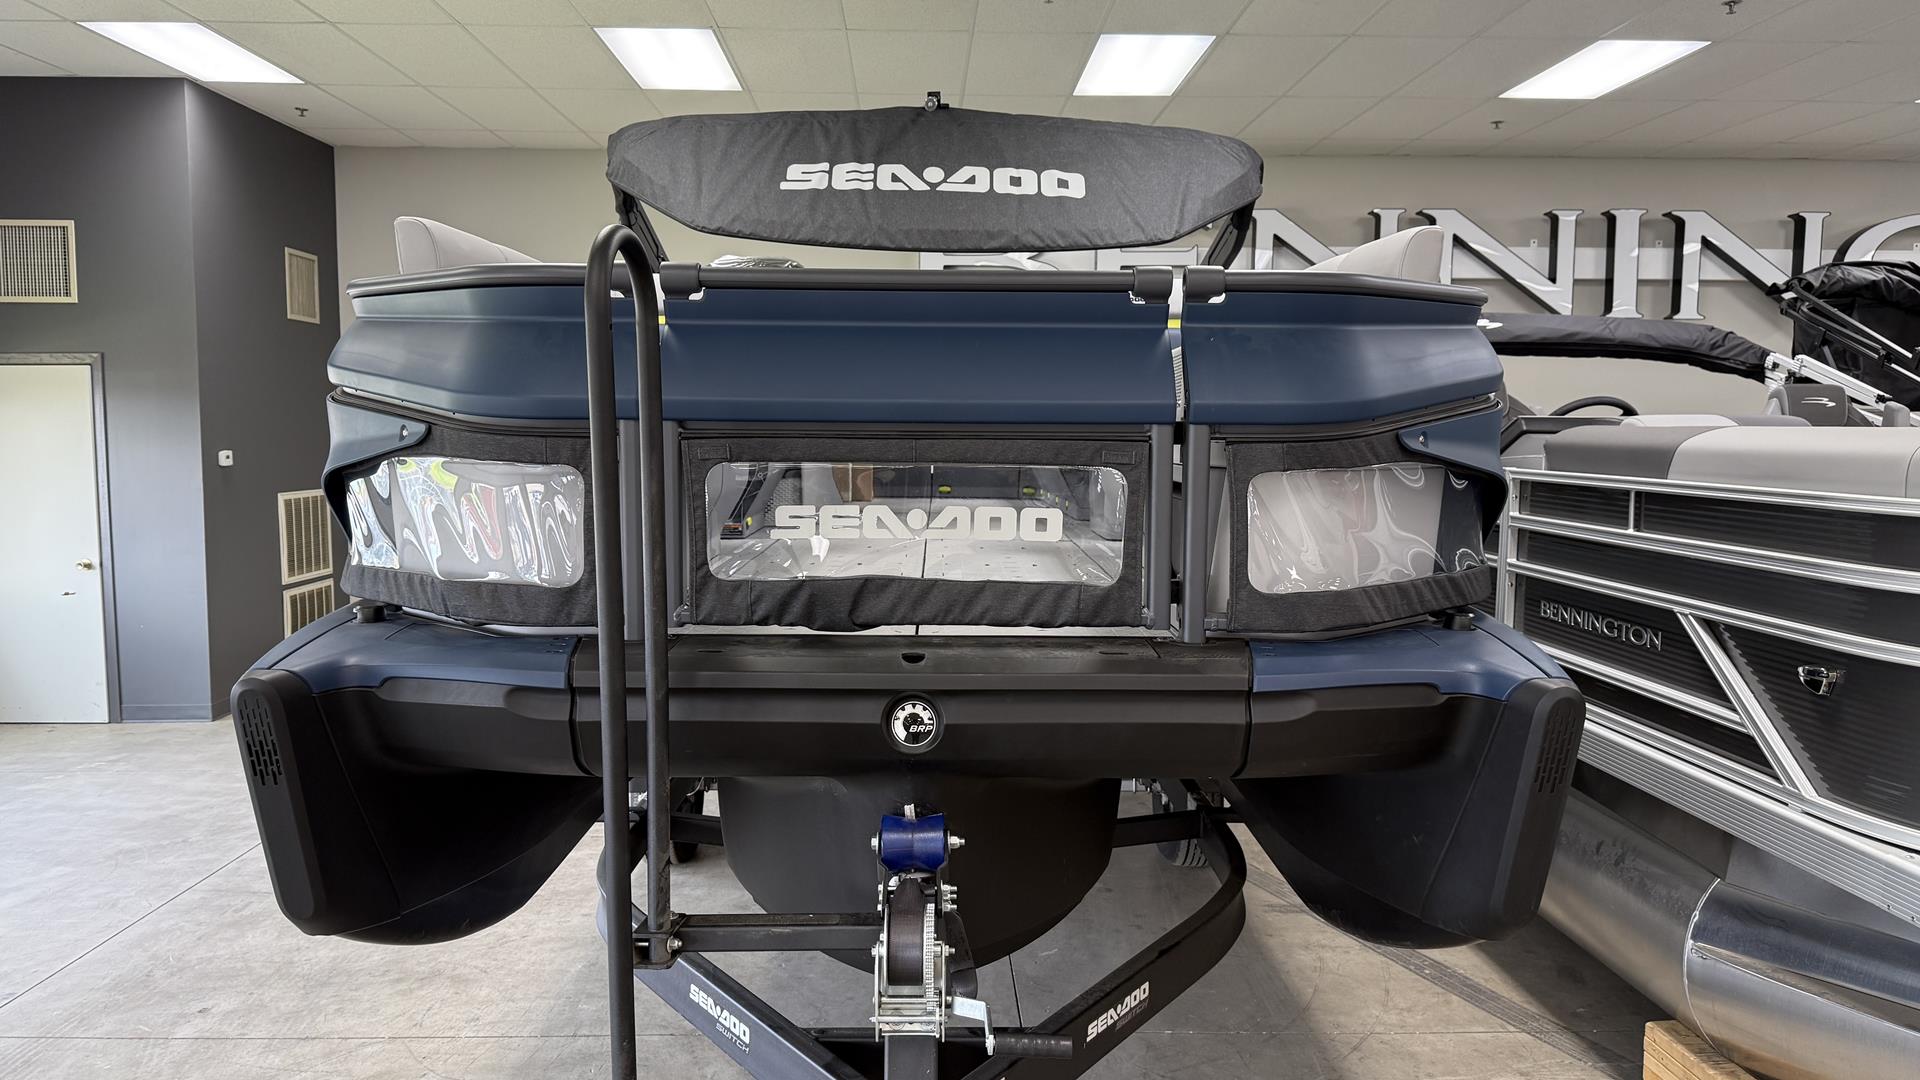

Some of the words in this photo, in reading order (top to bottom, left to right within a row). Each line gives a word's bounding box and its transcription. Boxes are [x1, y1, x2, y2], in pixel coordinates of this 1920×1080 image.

[1540, 600, 1662, 651] BENNINGTON
[909, 725, 933, 733] BRP
[715, 1022, 750, 1054] SWITCH
